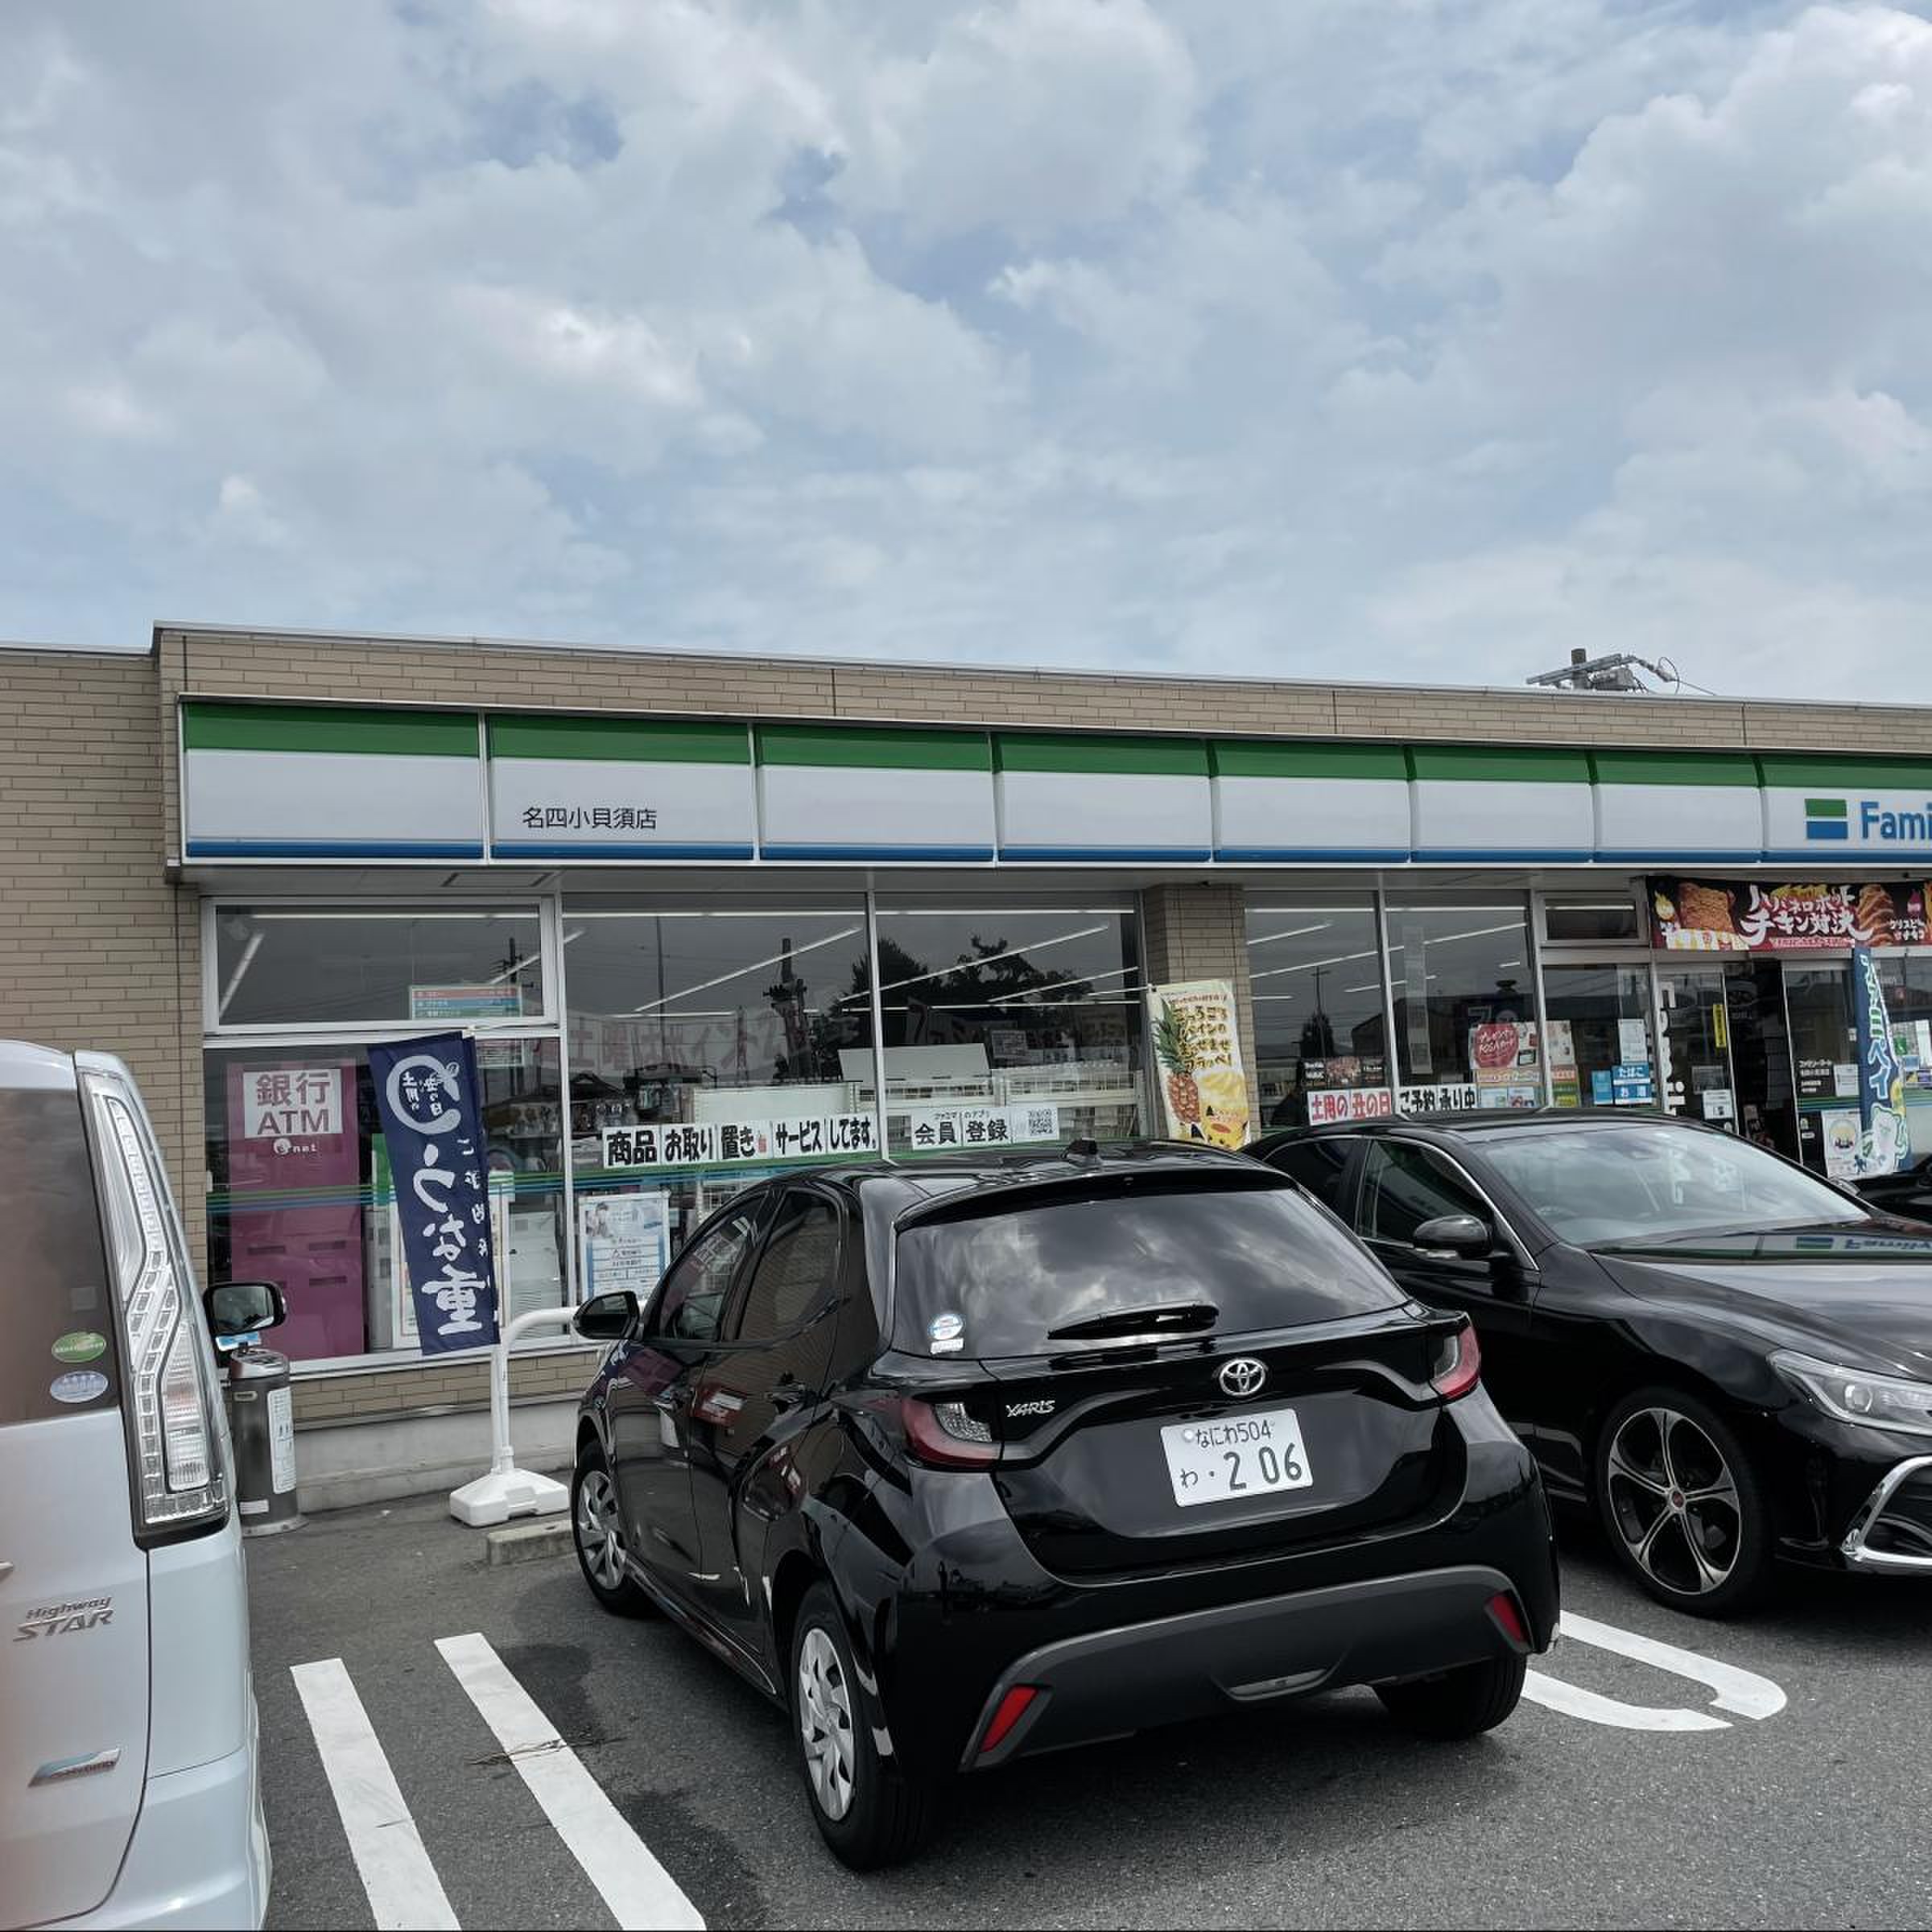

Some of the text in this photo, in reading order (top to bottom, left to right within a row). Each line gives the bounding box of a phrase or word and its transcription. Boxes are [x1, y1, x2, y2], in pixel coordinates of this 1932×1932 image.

[522, 807, 657, 829] 名四小貝須店
[1617, 1067, 1645, 1077] たばこ
[255, 1071, 331, 1107] 銀行
[257, 1108, 330, 1136] ATM
[1005, 1400, 1055, 1417] YARIS
[1180, 1468, 1199, 1488] わ
[26, 1596, 112, 1619] Highway
[13, 1608, 114, 1641] STAR
